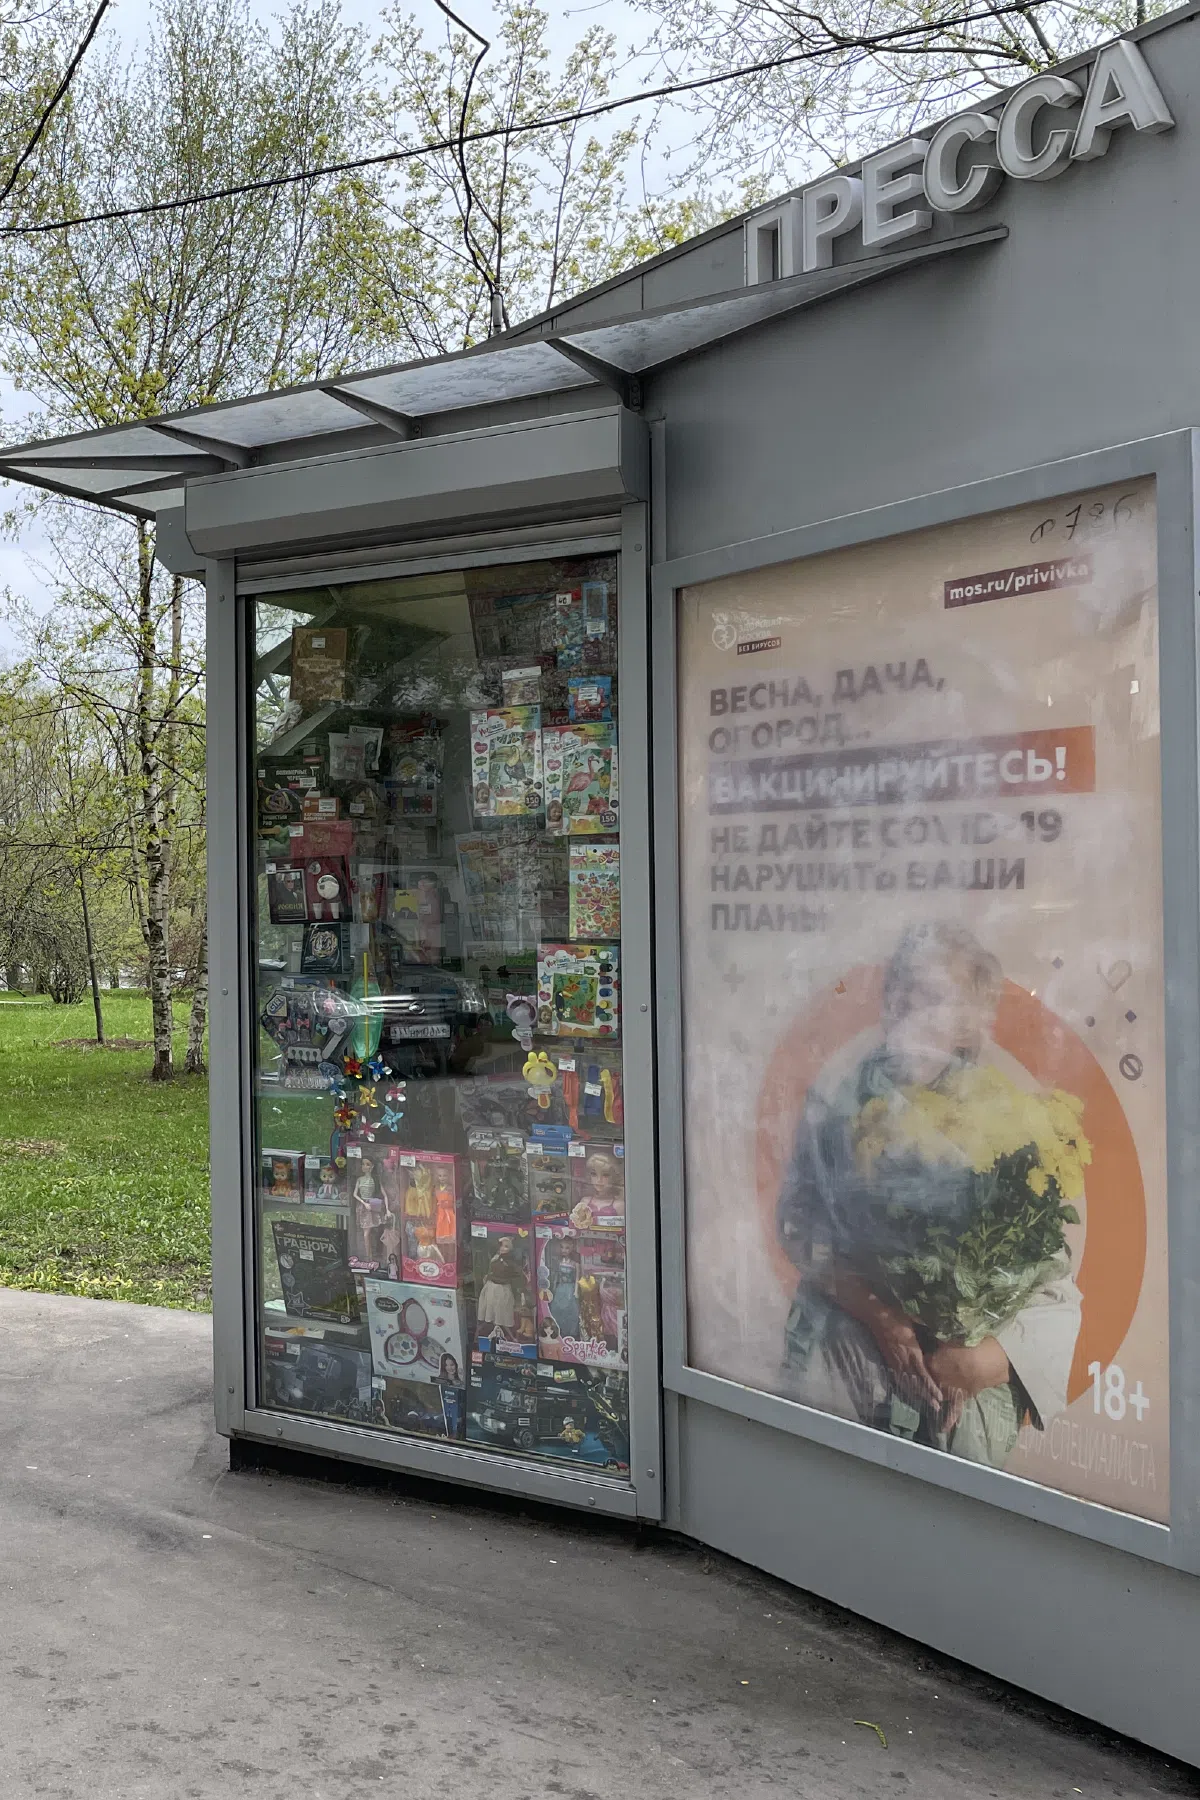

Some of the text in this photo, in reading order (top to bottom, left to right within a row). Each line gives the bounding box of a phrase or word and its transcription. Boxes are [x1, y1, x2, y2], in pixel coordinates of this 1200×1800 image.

[743, 40, 1175, 287] ПРЕССА
[949, 560, 1090, 601] mos.ru/privivka
[751, 639, 780, 650] ВИРУСОВ
[709, 658, 947, 716] ВЕСНА, ДАЧА,
[714, 746, 1067, 804] ВАКЦИНИРУЙТЕСЬ!
[601, 815, 615, 823] 150
[710, 825, 750, 854] НЕ
[757, 813, 872, 857] ДАЙТЕ
[710, 857, 1026, 892] НАРУШИТЬ ВАШИ
[275, 1235, 338, 1254] ГРАВЮРА
[1088, 1361, 1150, 1421] 18+
[1051, 1416, 1157, 1492] СПЕЦИАЛИСТА
